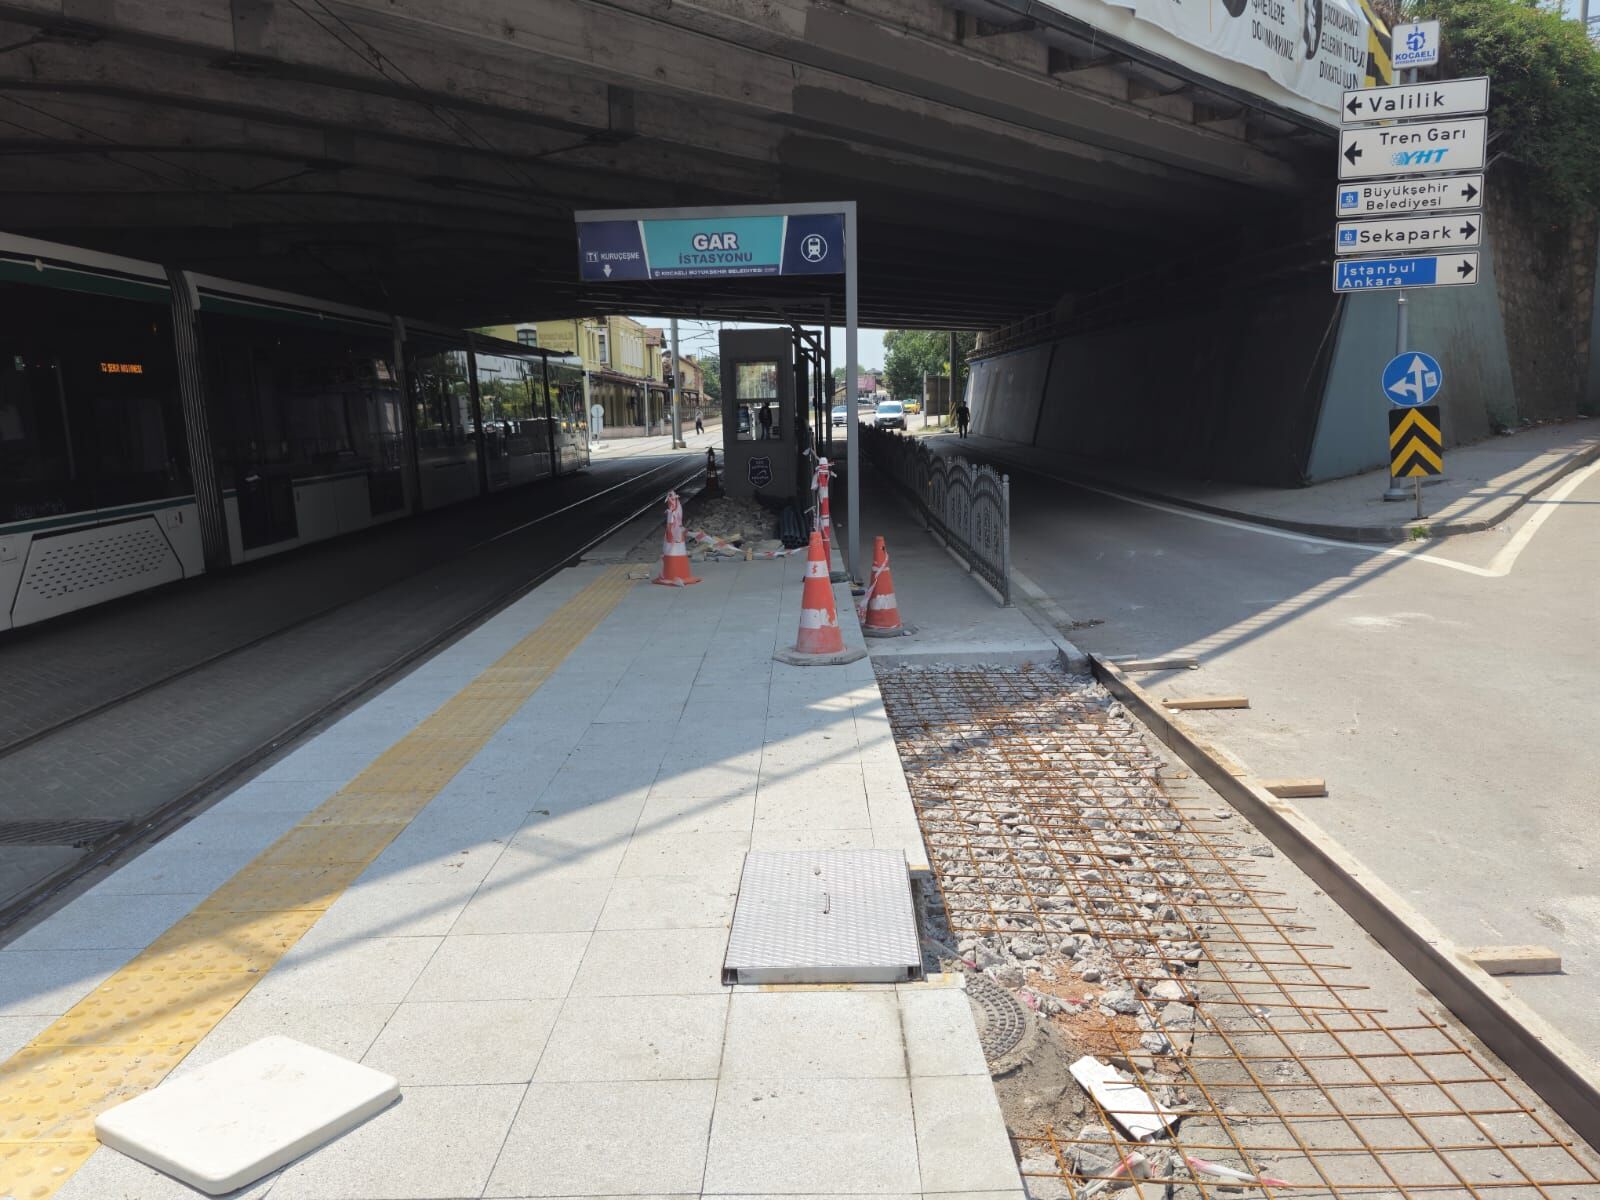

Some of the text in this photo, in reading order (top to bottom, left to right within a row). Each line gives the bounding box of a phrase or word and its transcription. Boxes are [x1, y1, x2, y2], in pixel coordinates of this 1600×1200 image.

[1395, 48, 1436, 61] KOCAELİ
[1369, 91, 1445, 112] Valilik
[1379, 128, 1466, 145] Tren Garı
[1403, 148, 1449, 166] YHT
[1363, 183, 1449, 199] Büyükşehir
[1366, 197, 1442, 211] Belediyesi
[692, 232, 738, 251] GAR
[1360, 226, 1452, 244] Sekapark
[586, 252, 598, 262] T1
[678, 252, 753, 265] İSTASYONU
[1343, 262, 1416, 276] İstanbul
[1342, 277, 1403, 288] Ankara
